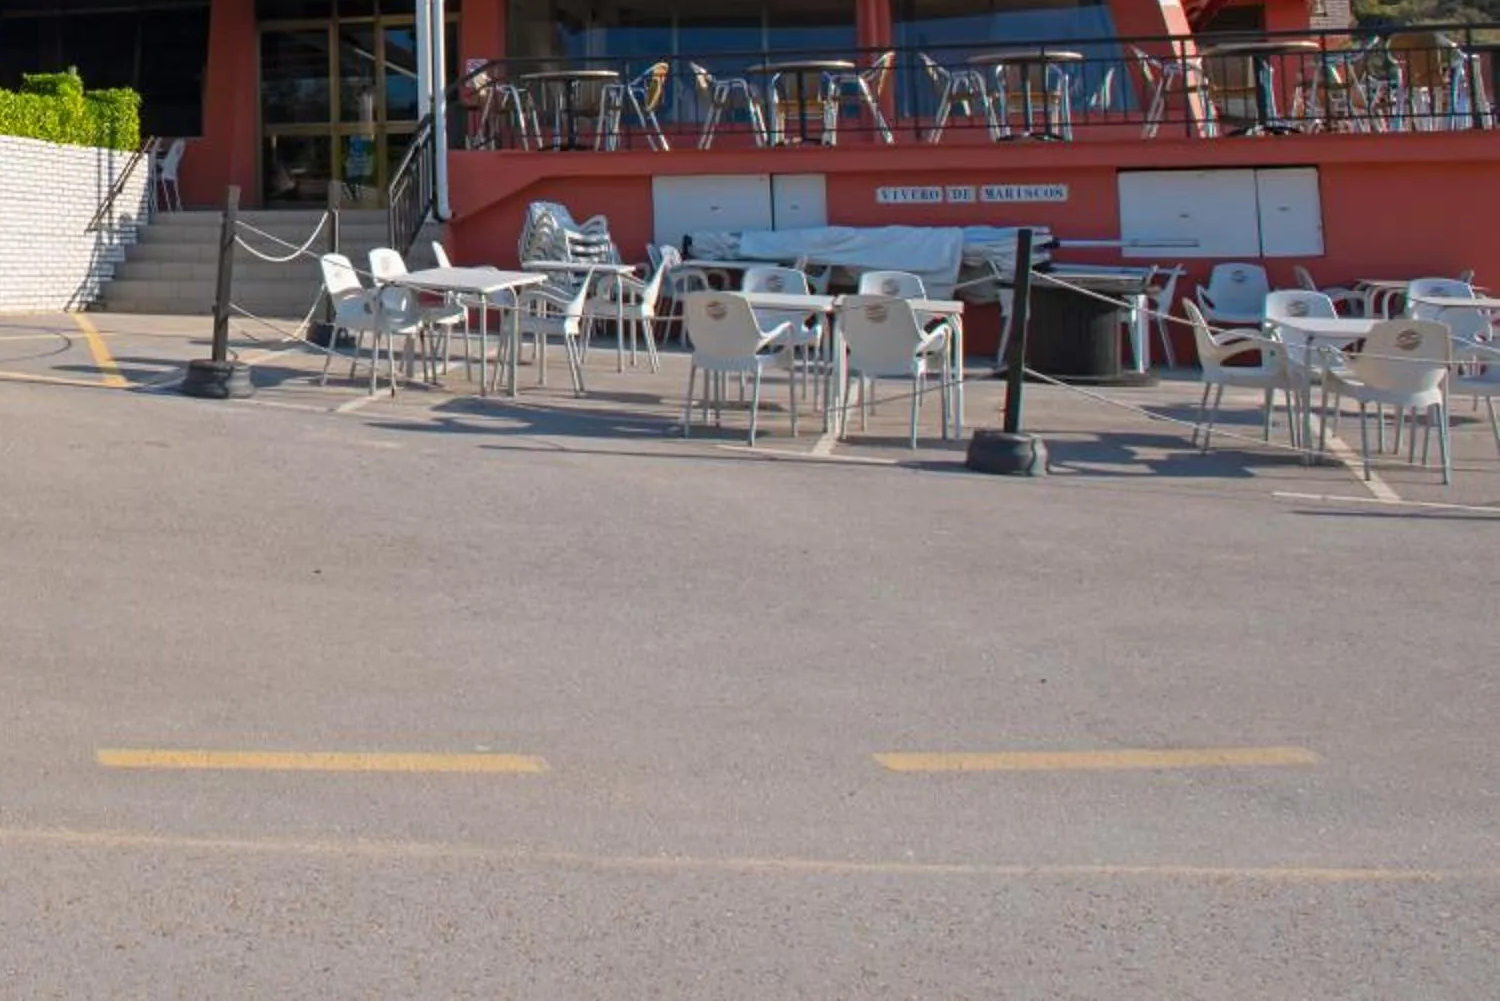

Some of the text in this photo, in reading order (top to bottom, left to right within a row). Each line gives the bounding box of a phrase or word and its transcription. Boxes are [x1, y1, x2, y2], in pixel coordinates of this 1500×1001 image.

[880, 186, 1065, 201] VIVERO DE MARISCOS
